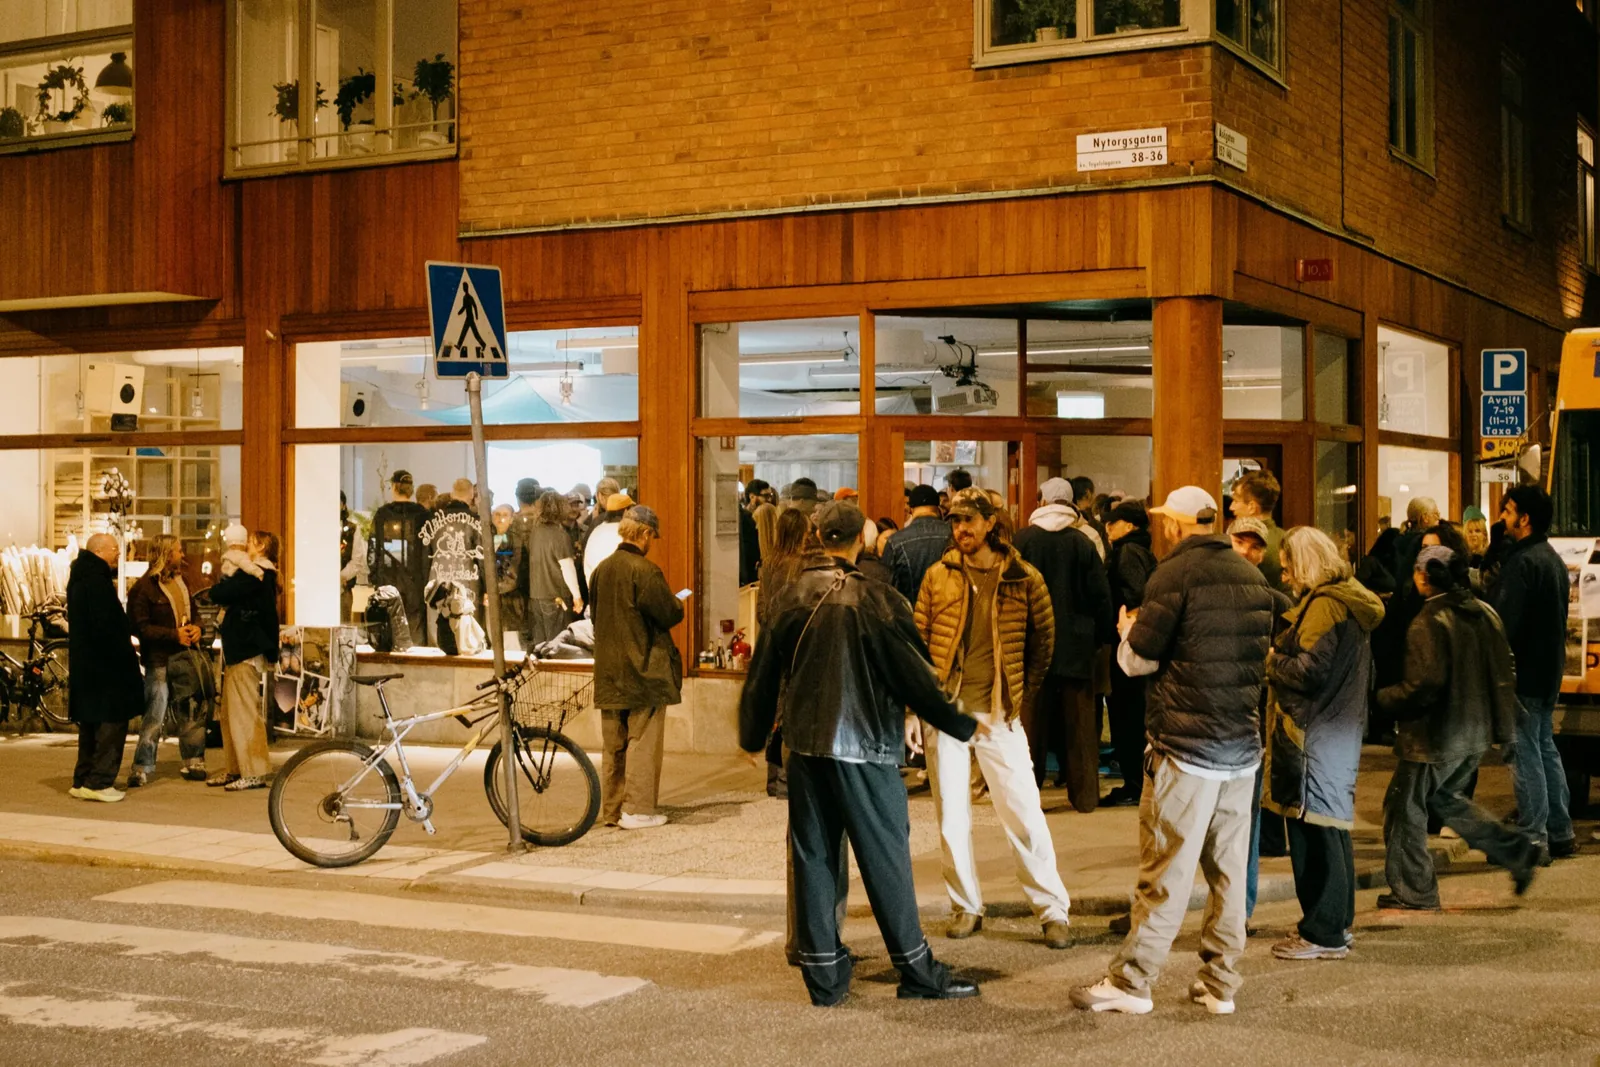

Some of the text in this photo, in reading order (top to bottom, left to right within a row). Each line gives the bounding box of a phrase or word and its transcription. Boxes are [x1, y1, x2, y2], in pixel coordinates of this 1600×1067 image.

[1093, 135, 1163, 151] Nytorgsgatan
[1131, 150, 1163, 163] 38-36
[1493, 353, 1519, 389] P
[1487, 396, 1521, 406] Avgift
[1493, 406, 1515, 415] 7-19
[1489, 416, 1519, 426] (11-17)
[1485, 426, 1522, 435] Taxa 3
[431, 562, 480, 583] Verkstad
